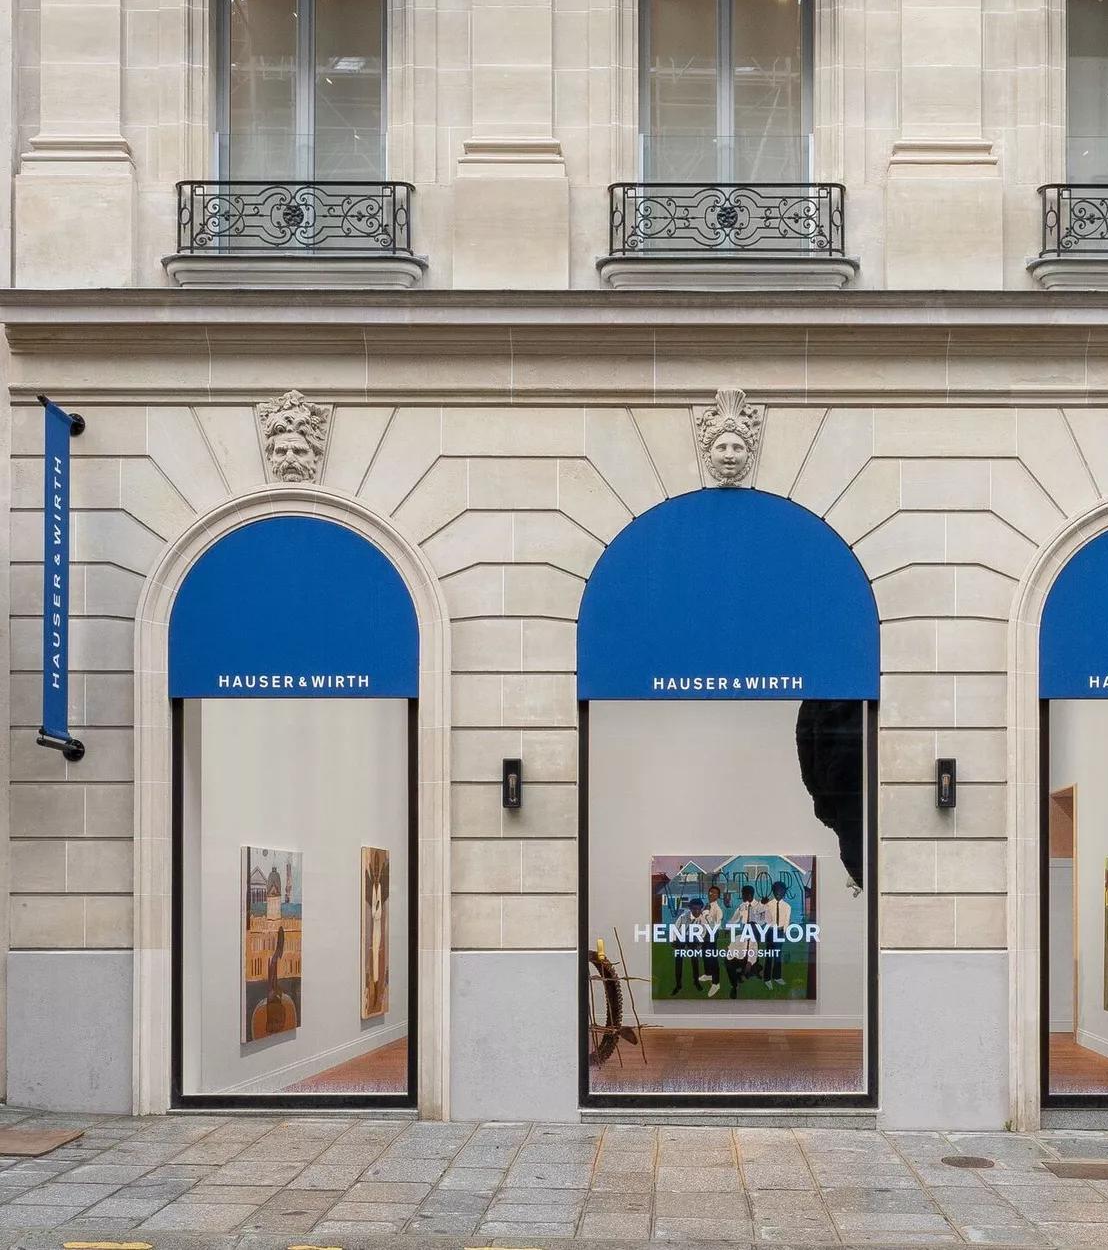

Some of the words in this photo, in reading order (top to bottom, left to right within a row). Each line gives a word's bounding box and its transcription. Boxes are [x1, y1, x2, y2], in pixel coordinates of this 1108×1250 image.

[53, 456, 62, 545] WIRTH
[53, 553, 62, 566] &
[52, 573, 62, 689] HAUSER
[218, 675, 294, 688] HAUSER
[298, 676, 308, 688] &
[311, 675, 369, 688] WIRTH
[653, 676, 728, 690] HAUSER
[732, 677, 742, 690] &
[745, 676, 803, 690] WIRTH
[634, 923, 720, 943] HENRY
[724, 923, 821, 943] TAYLOR
[674, 949, 703, 958] FROM
[705, 949, 740, 958] SUGAR
[743, 949, 755, 958] TO
[757, 949, 781, 958] SHIT
